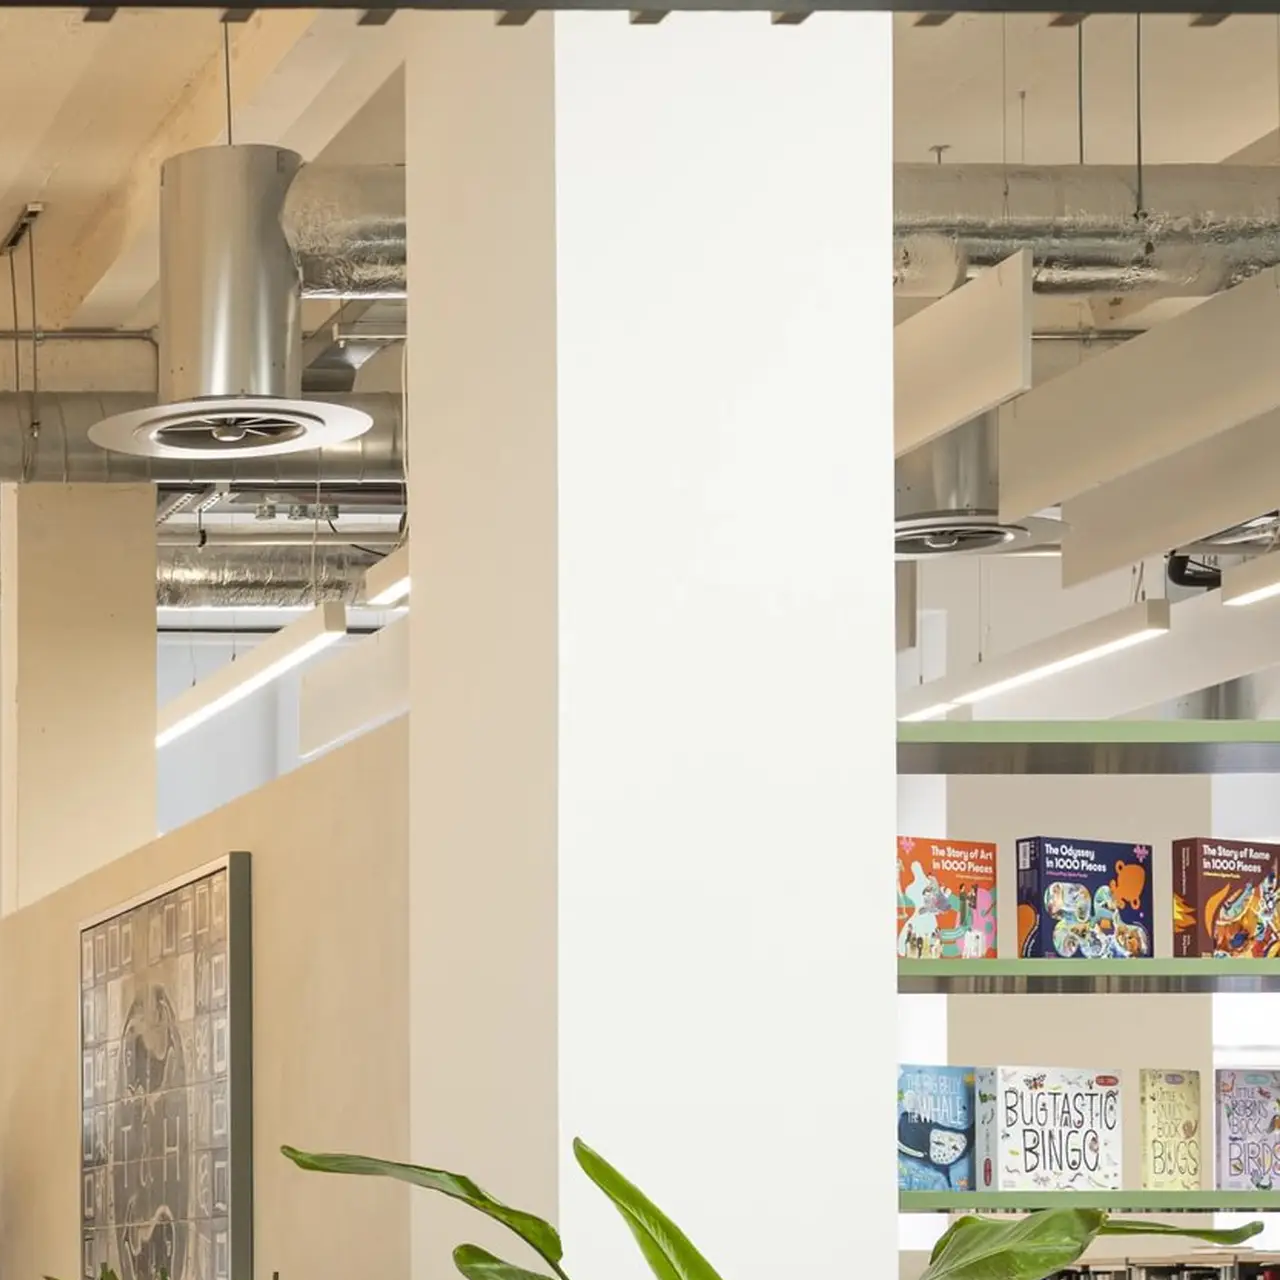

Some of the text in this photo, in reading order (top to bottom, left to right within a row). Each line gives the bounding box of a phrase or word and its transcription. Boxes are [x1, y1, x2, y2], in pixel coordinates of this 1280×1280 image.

[931, 845, 993, 861] The Story of Art
[1045, 843, 1095, 860] The Odyssey
[1202, 844, 1271, 860] The Story of Rome
[932, 858, 993, 873] in 1000 Pieces
[1045, 857, 1107, 872] in 1000 Pieces
[1202, 858, 1262, 873] in 1000 Pieces
[1004, 1090, 1117, 1130] BUGTASTIC
[1023, 1129, 1099, 1173] BINGO
[1152, 1139, 1199, 1176] BUGS
[1229, 1142, 1280, 1176] BIRDS
